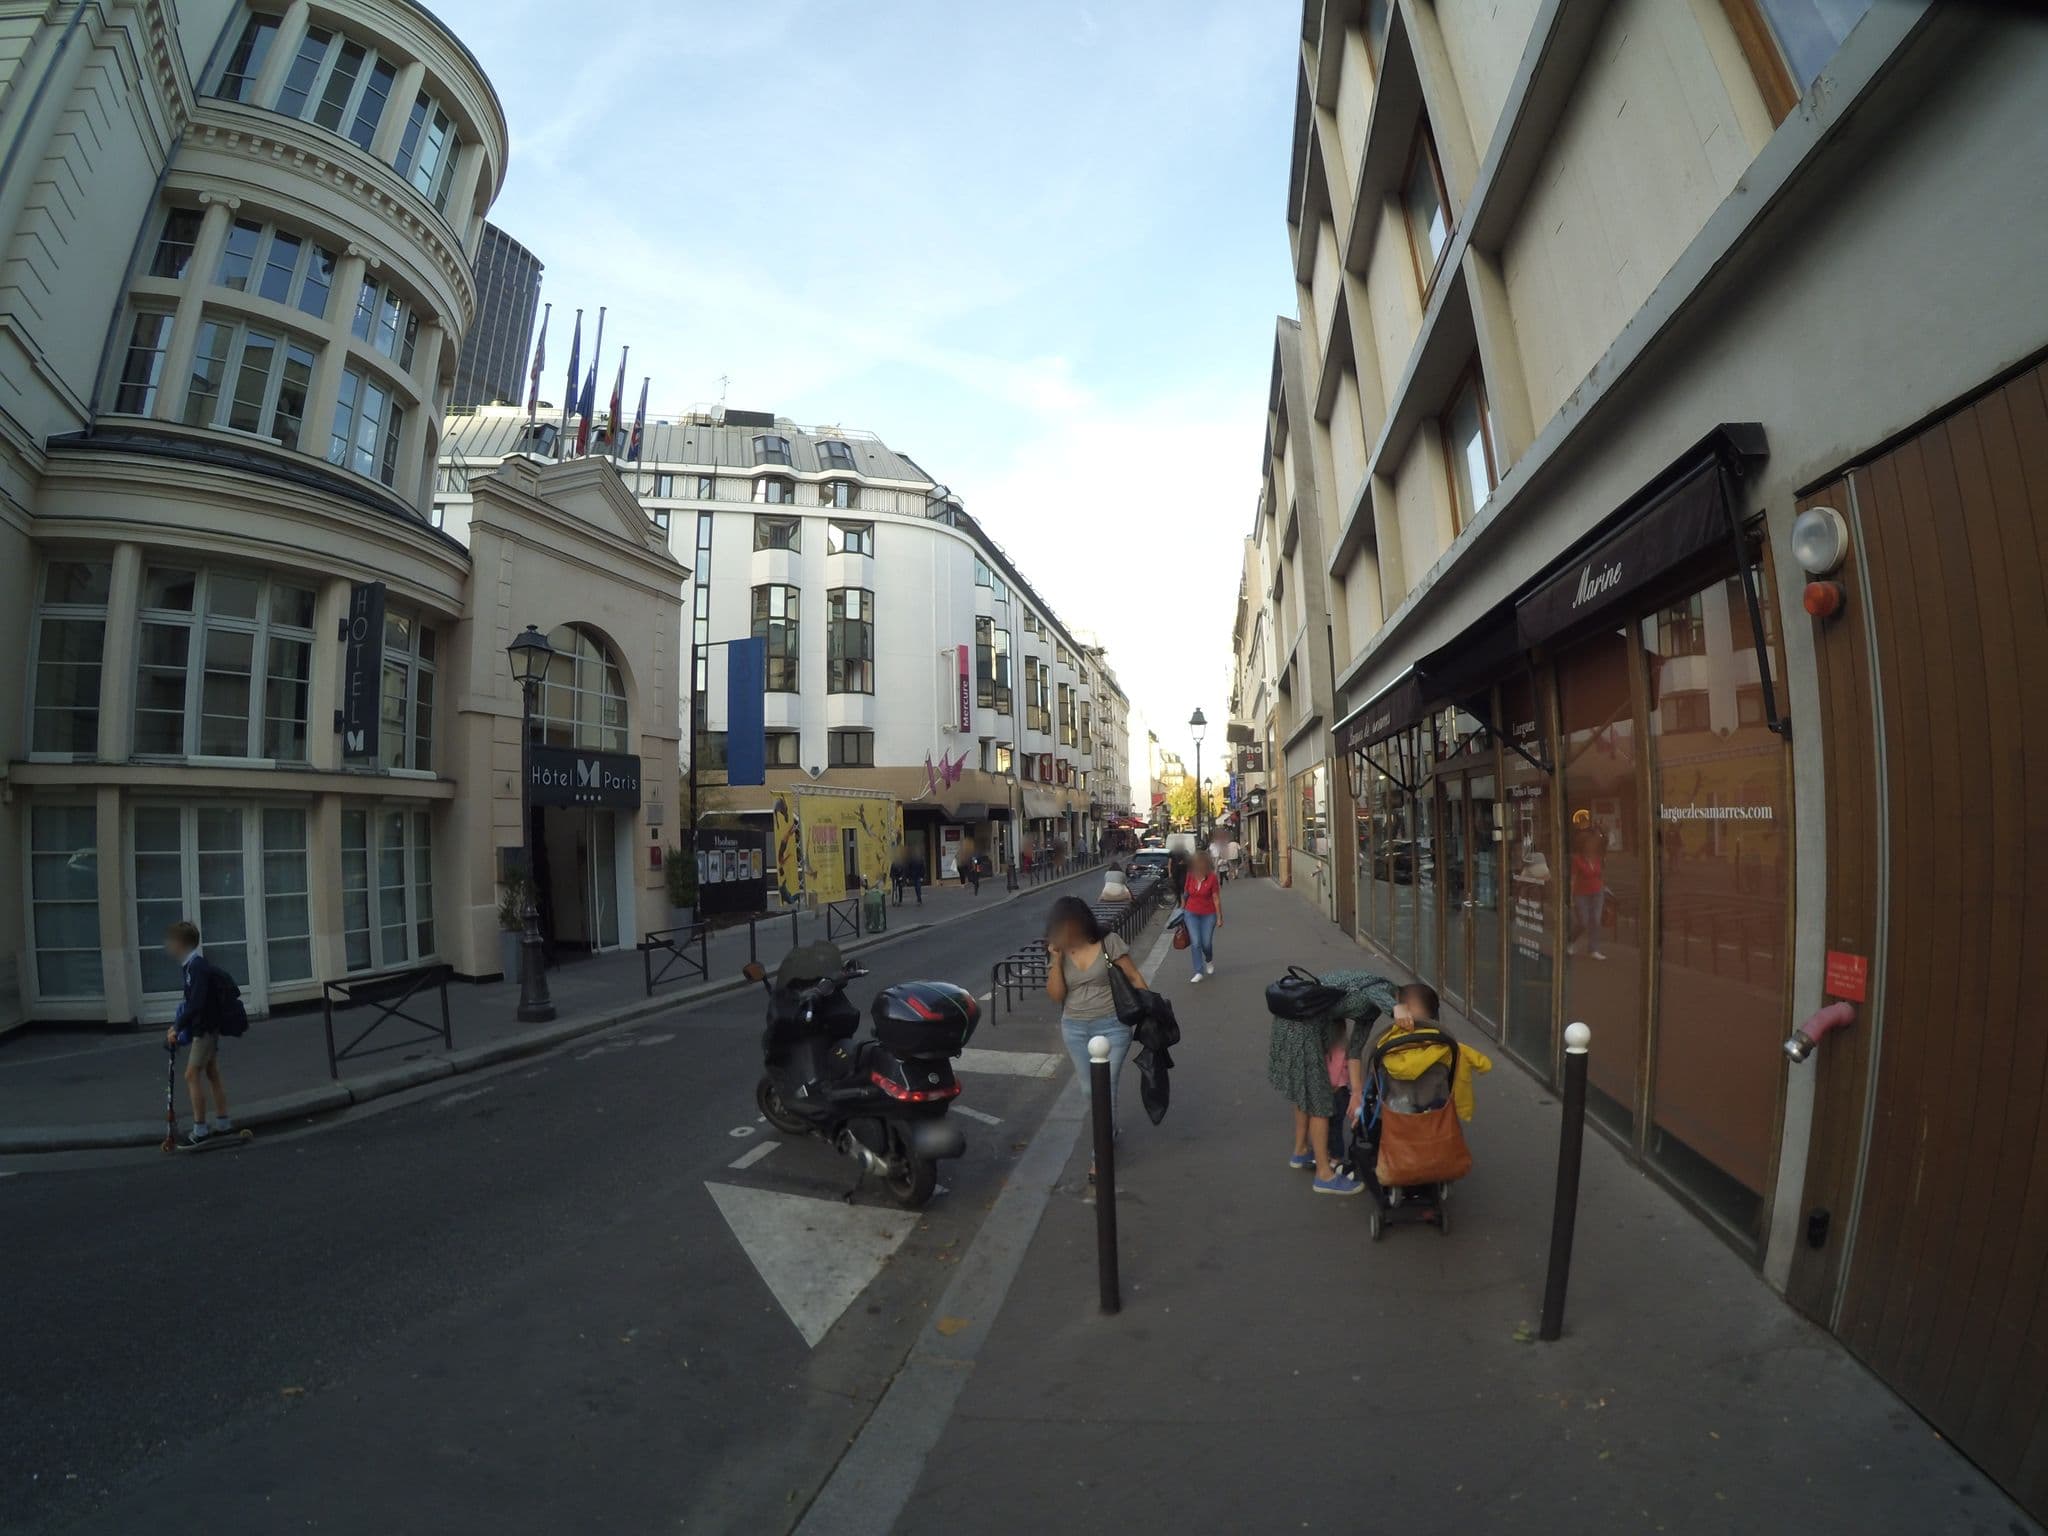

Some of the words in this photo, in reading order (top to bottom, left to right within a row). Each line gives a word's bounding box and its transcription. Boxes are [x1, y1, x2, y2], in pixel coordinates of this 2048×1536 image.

[1572, 562, 1622, 608] Marine
[351, 589, 369, 724] HOTEL
[1237, 744, 1262, 755] Pho
[532, 765, 573, 787] Hôtel
[576, 759, 600, 788] M
[604, 771, 638, 791] Paris
[1660, 803, 1773, 823] larguezlesamarres.com
